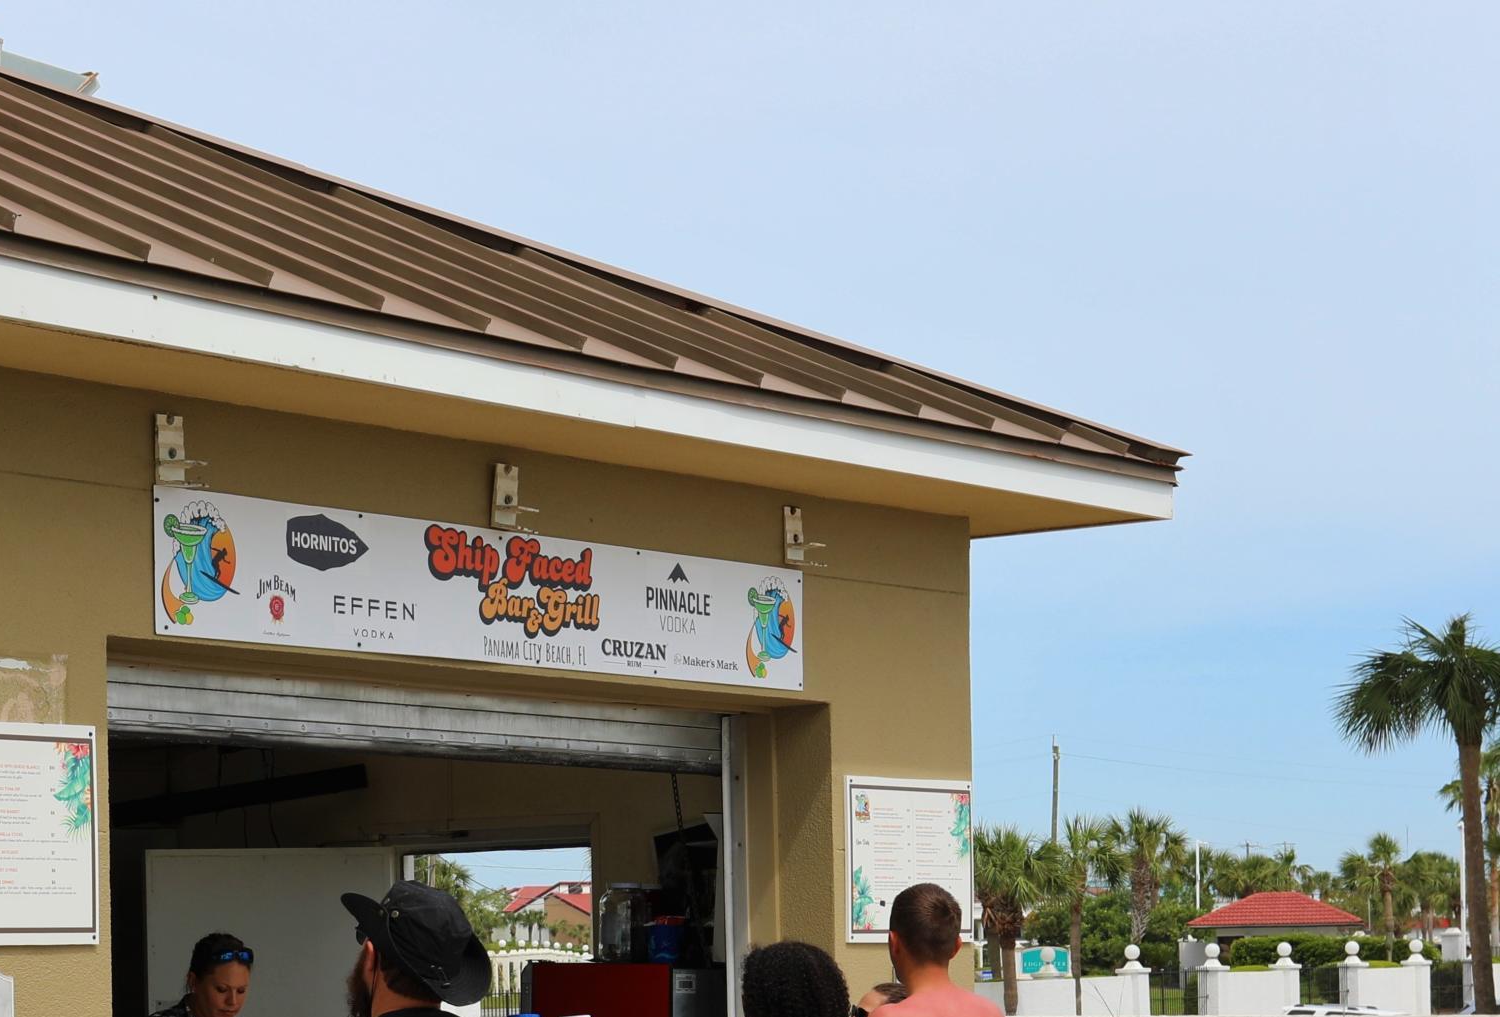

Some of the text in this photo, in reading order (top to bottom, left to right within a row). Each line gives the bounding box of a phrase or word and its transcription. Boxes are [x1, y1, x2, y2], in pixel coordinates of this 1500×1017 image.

[291, 530, 358, 555] HORNITOS
[426, 525, 592, 591] Ship Faced
[256, 574, 297, 602] JIM BEAM
[645, 586, 711, 616] PINNACLE
[333, 595, 415, 621] EFFEN
[481, 578, 536, 622] Bar
[539, 586, 600, 632] Grill
[352, 627, 395, 640] VODKA
[659, 615, 697, 635] VODKA
[483, 635, 520, 660] PANAMA
[577, 645, 588, 666] FL
[601, 637, 667, 660] CRUZAN
[682, 654, 739, 672] Maker's Mark
